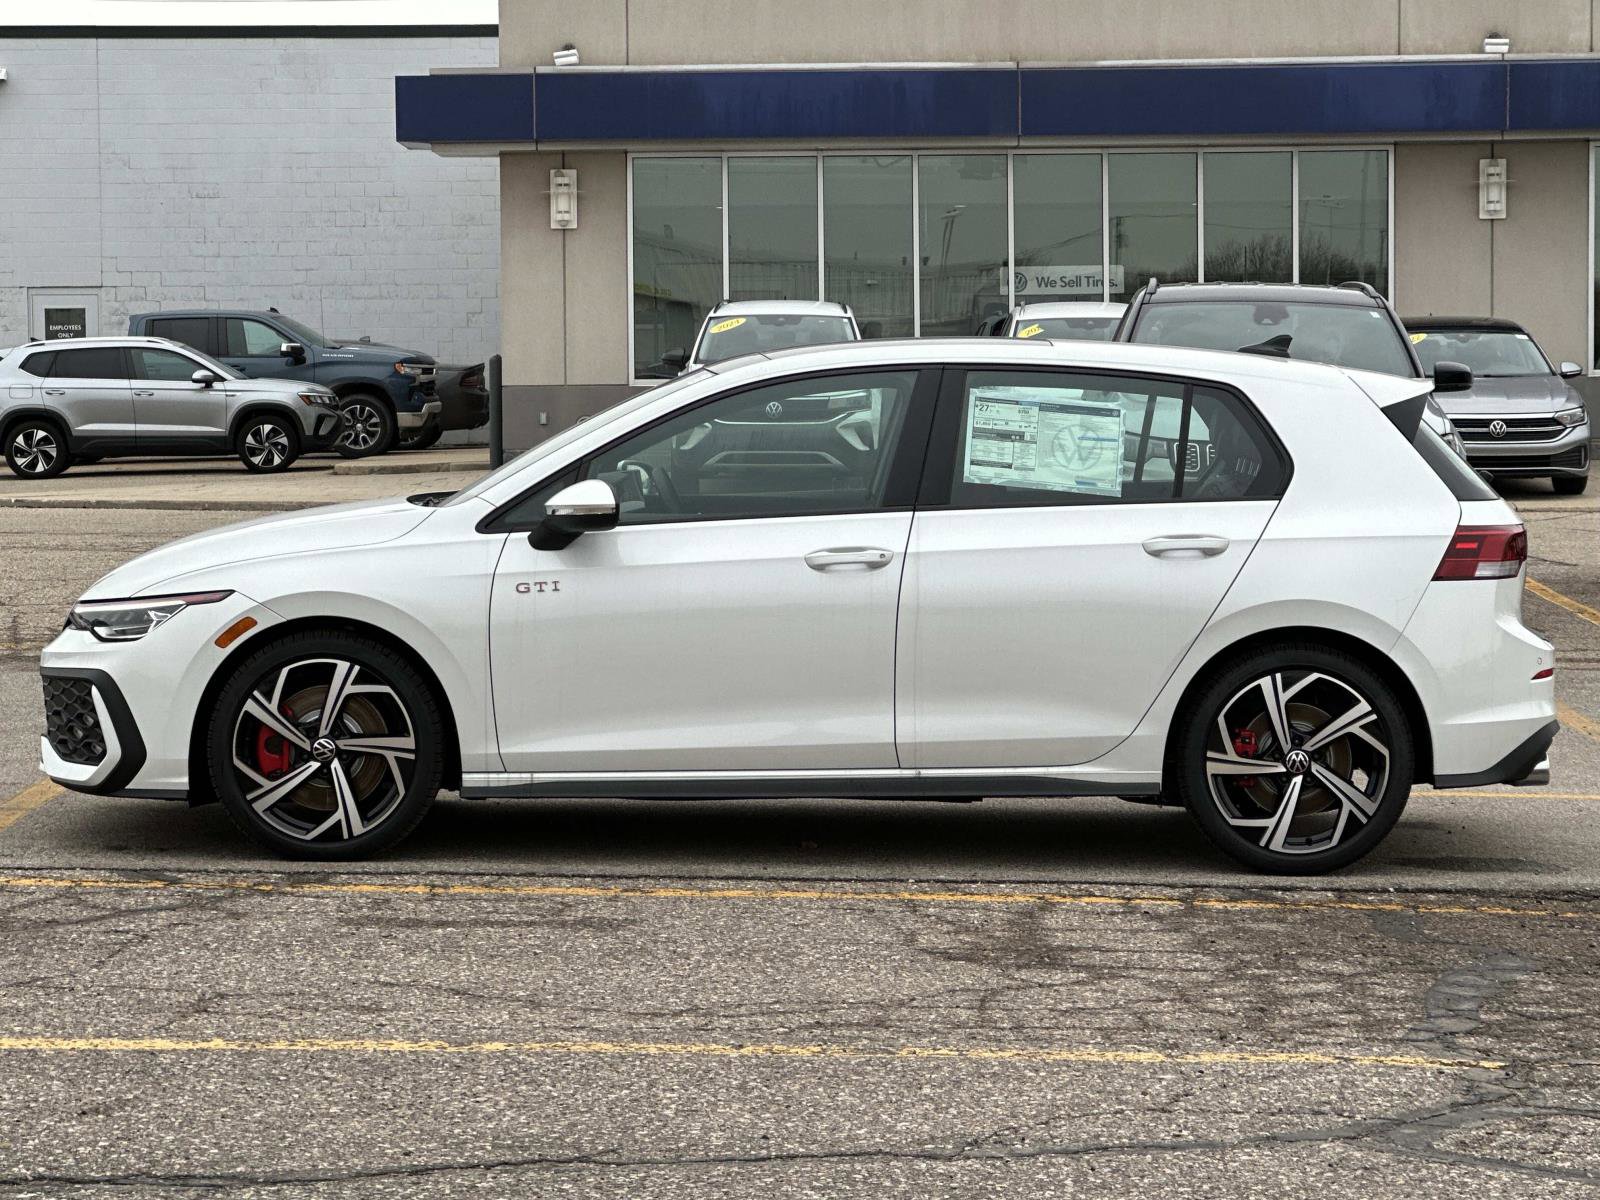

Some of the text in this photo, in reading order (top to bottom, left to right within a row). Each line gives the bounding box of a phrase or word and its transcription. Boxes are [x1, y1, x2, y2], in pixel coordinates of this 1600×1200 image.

[1035, 275, 1118, 289] We Sell Tirs.
[978, 403, 990, 412] 27
[515, 580, 560, 594] GTI
